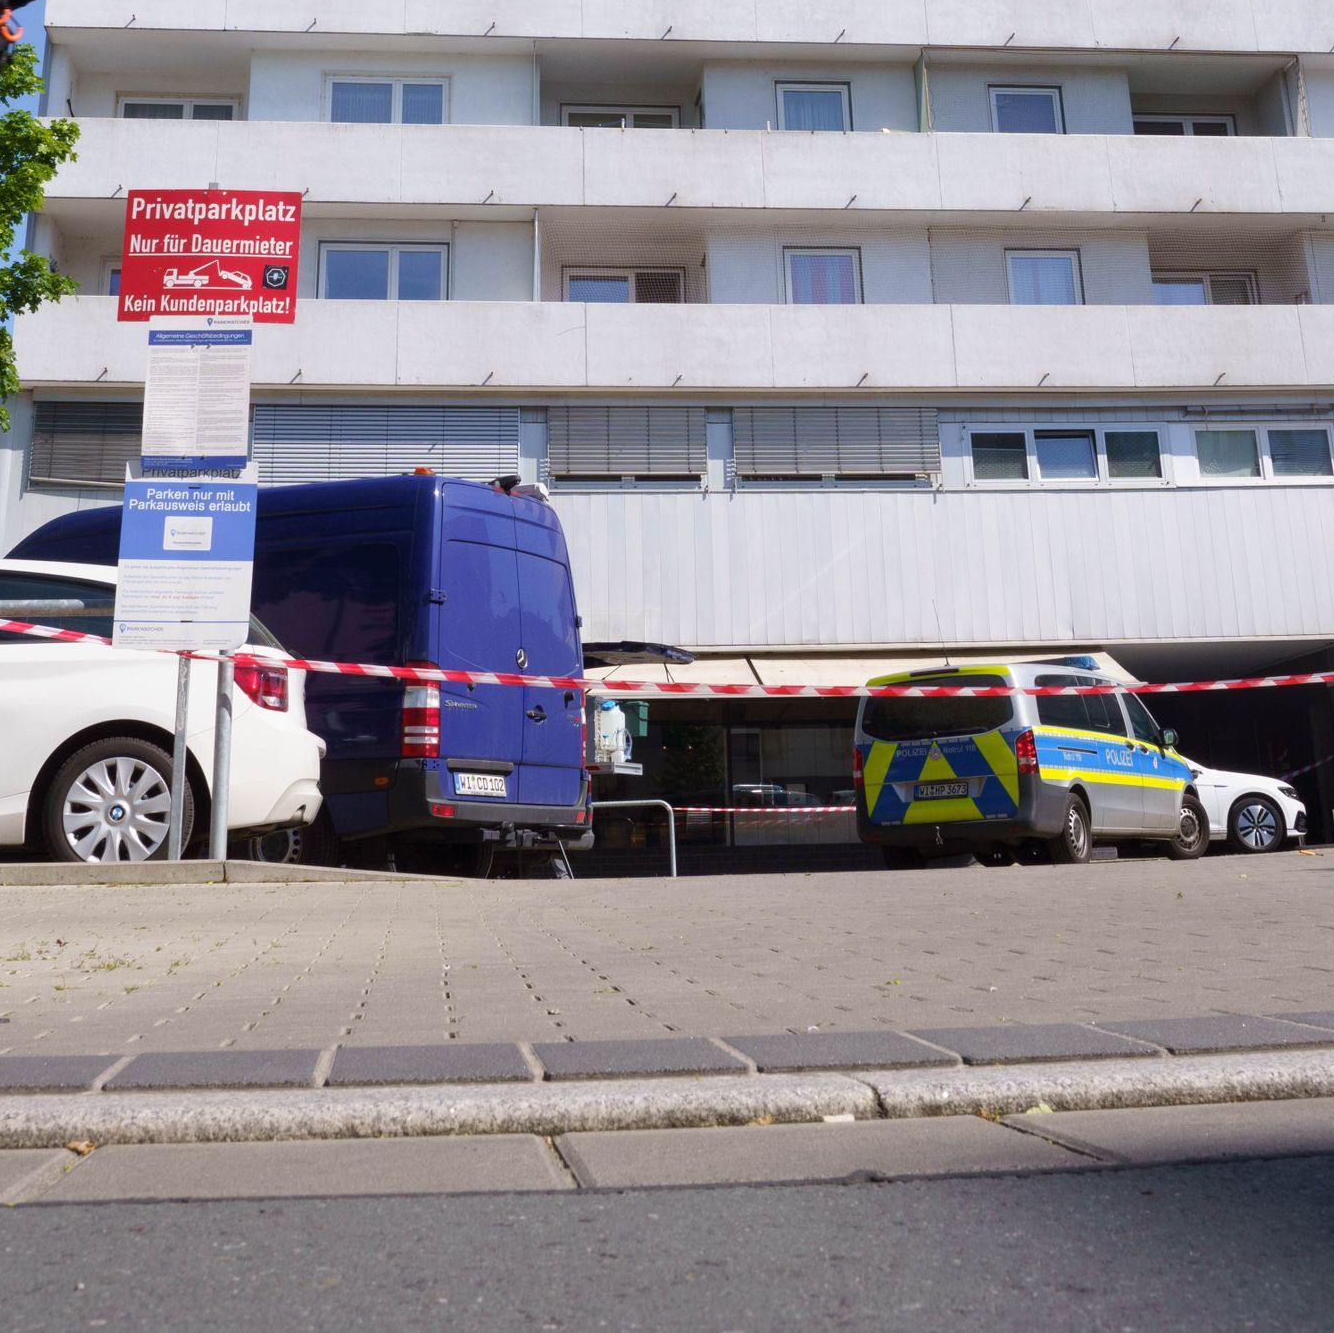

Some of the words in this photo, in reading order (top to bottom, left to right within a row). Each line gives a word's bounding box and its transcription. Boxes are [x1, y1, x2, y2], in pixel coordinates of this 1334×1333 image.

[131, 197, 296, 226] Privatparkplatz
[130, 234, 159, 253] Nur
[163, 234, 187, 253] für
[191, 234, 293, 255] Dauermieter
[124, 295, 156, 312] Kein
[160, 295, 290, 315] Kundenparkplatz!
[147, 488, 189, 500] Parken
[193, 491, 213, 501] nur
[216, 490, 235, 501] mit
[129, 499, 205, 512] Parkausweis
[208, 500, 251, 513] erlaubt
[896, 747, 927, 758] POLIZEI
[1105, 748, 1134, 767] POLIZEI
[459, 776, 472, 790] WI
[919, 786, 930, 796] WI
